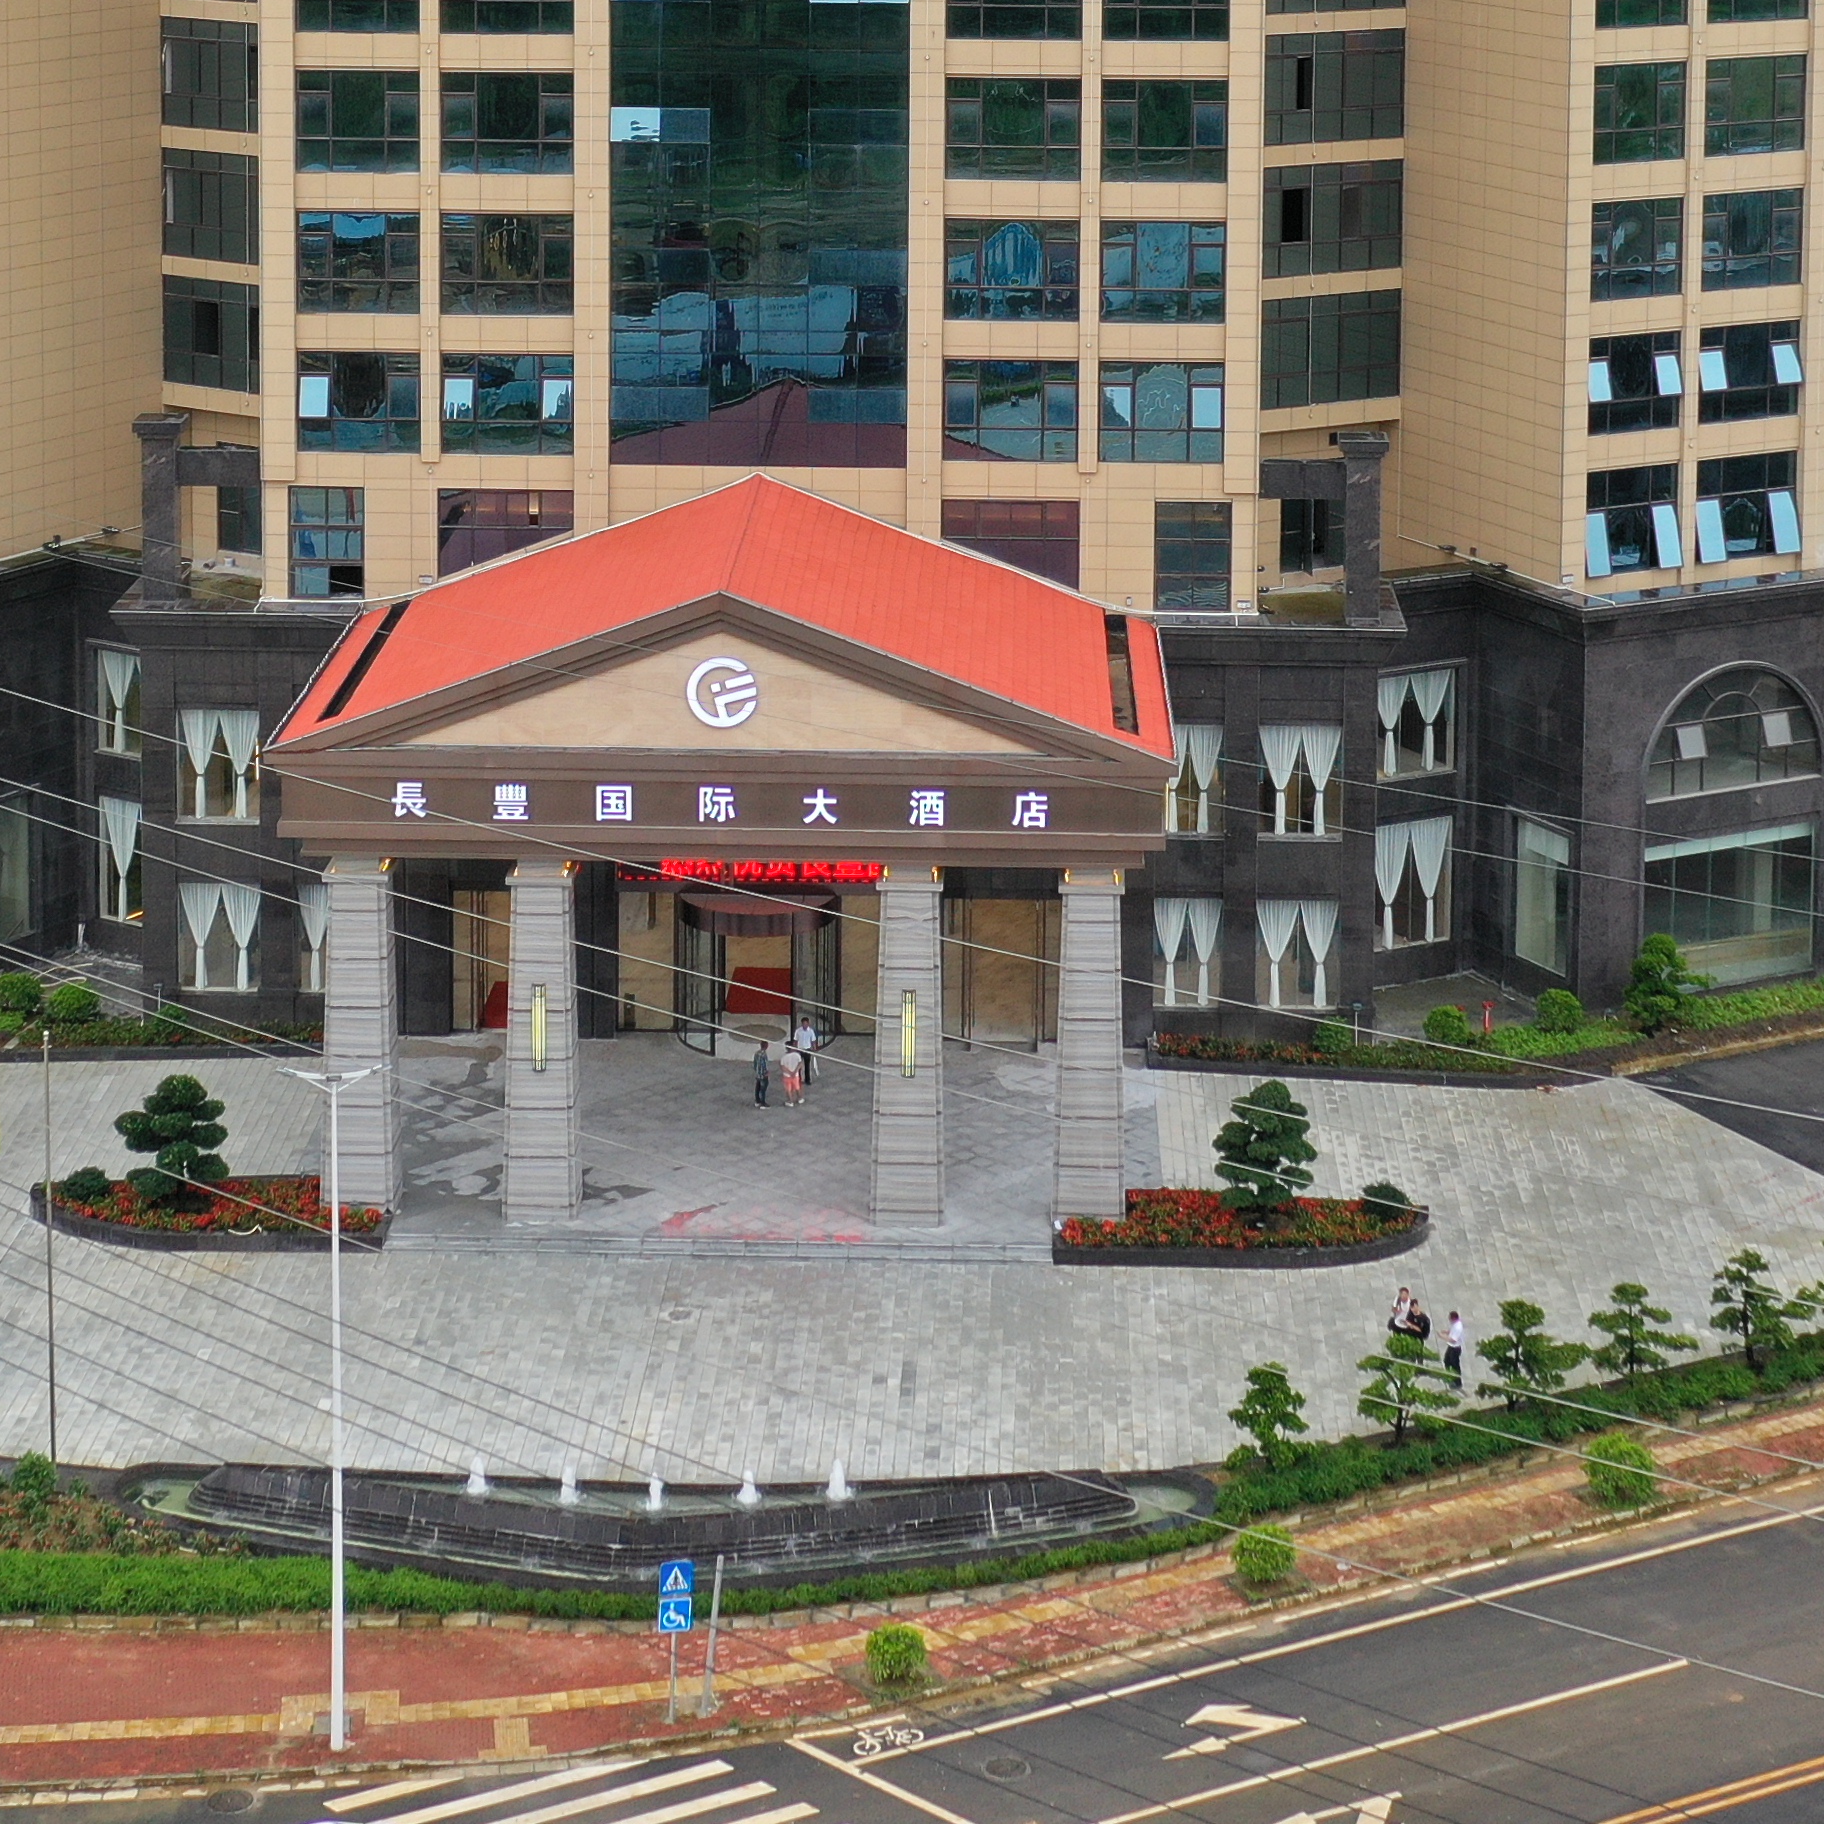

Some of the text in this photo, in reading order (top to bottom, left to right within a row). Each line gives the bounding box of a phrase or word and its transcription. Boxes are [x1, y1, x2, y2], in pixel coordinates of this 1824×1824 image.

[390, 781, 1049, 828] 長豐国际大酒店
